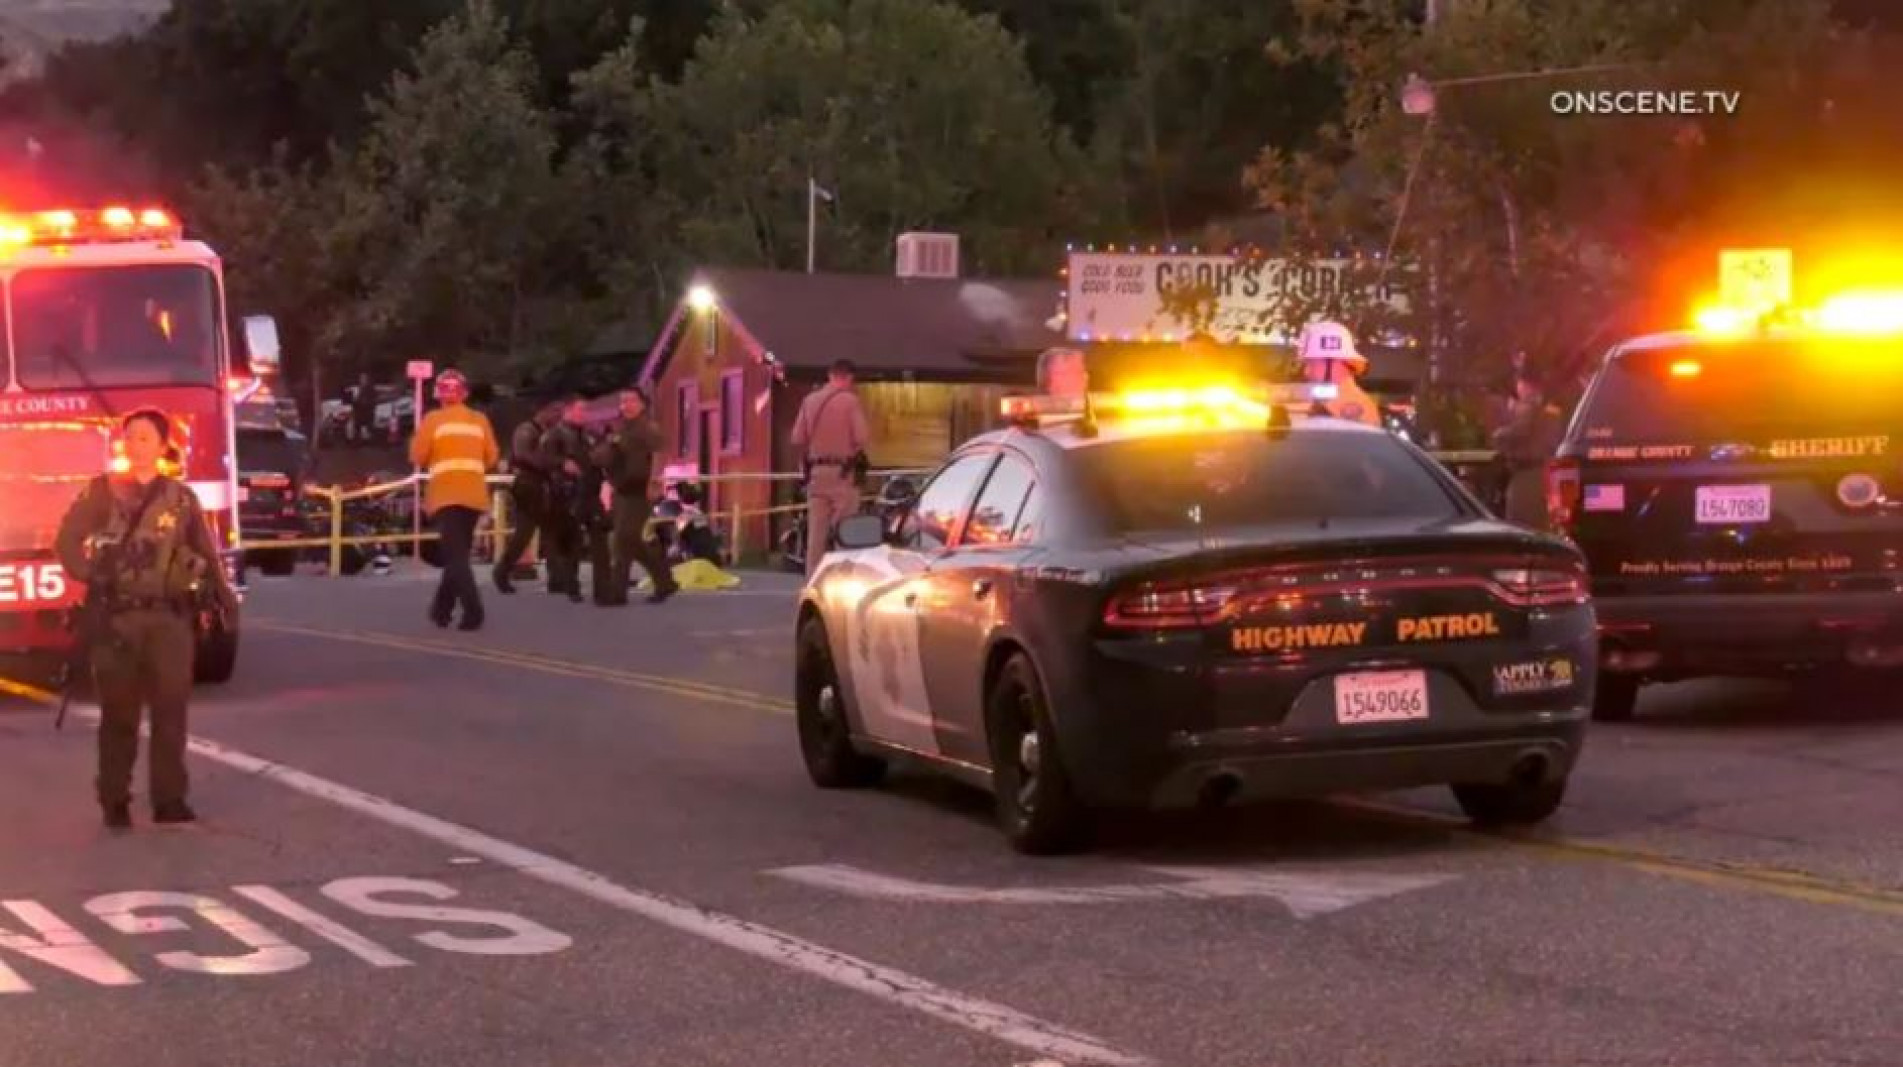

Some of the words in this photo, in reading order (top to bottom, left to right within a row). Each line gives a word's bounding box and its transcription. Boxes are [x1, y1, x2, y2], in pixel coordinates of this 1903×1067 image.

[16, 396, 91, 414] COUNTY
[1641, 444, 1695, 458] COUNTY
[1770, 436, 1889, 457] SHERIFF
[0, 564, 65, 600] E15
[1232, 622, 1366, 650] HIGHWAY
[1397, 612, 1499, 641] PATROL
[1343, 688, 1421, 718] 1549066
